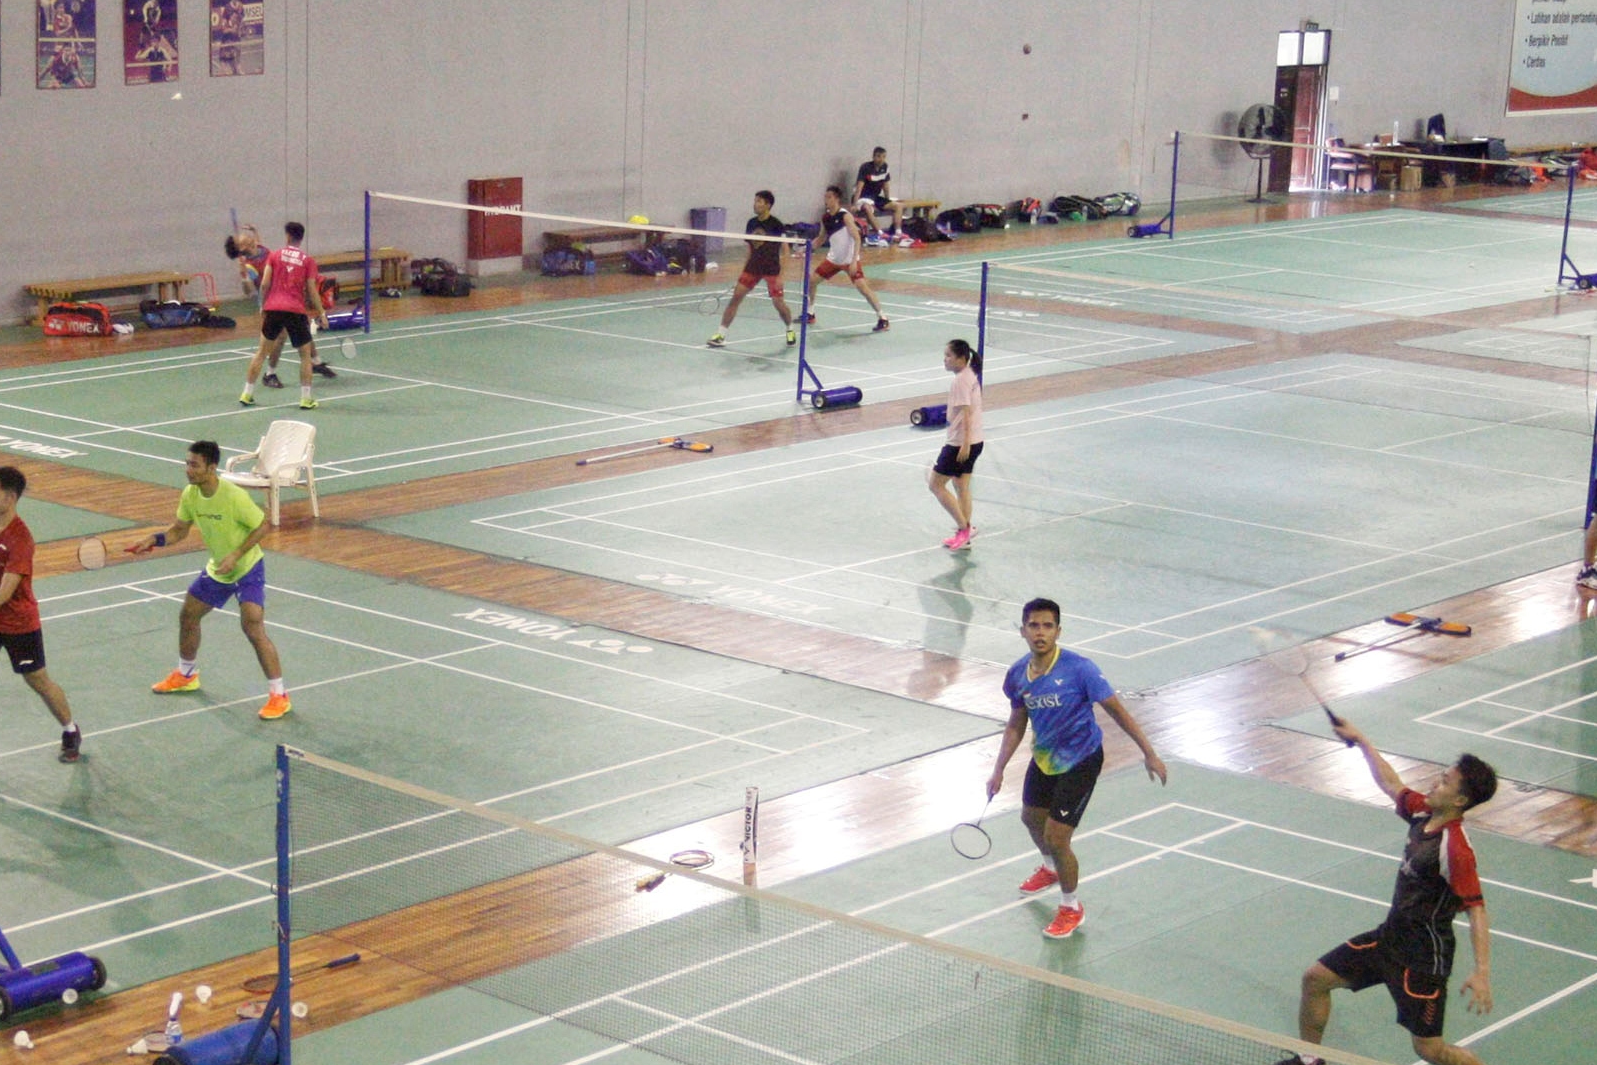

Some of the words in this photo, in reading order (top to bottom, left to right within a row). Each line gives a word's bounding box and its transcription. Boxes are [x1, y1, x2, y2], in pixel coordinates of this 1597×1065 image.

[66, 321, 100, 334] YONEX
[0, 438, 89, 459] YONEX
[451, 607, 578, 641] YONEX
